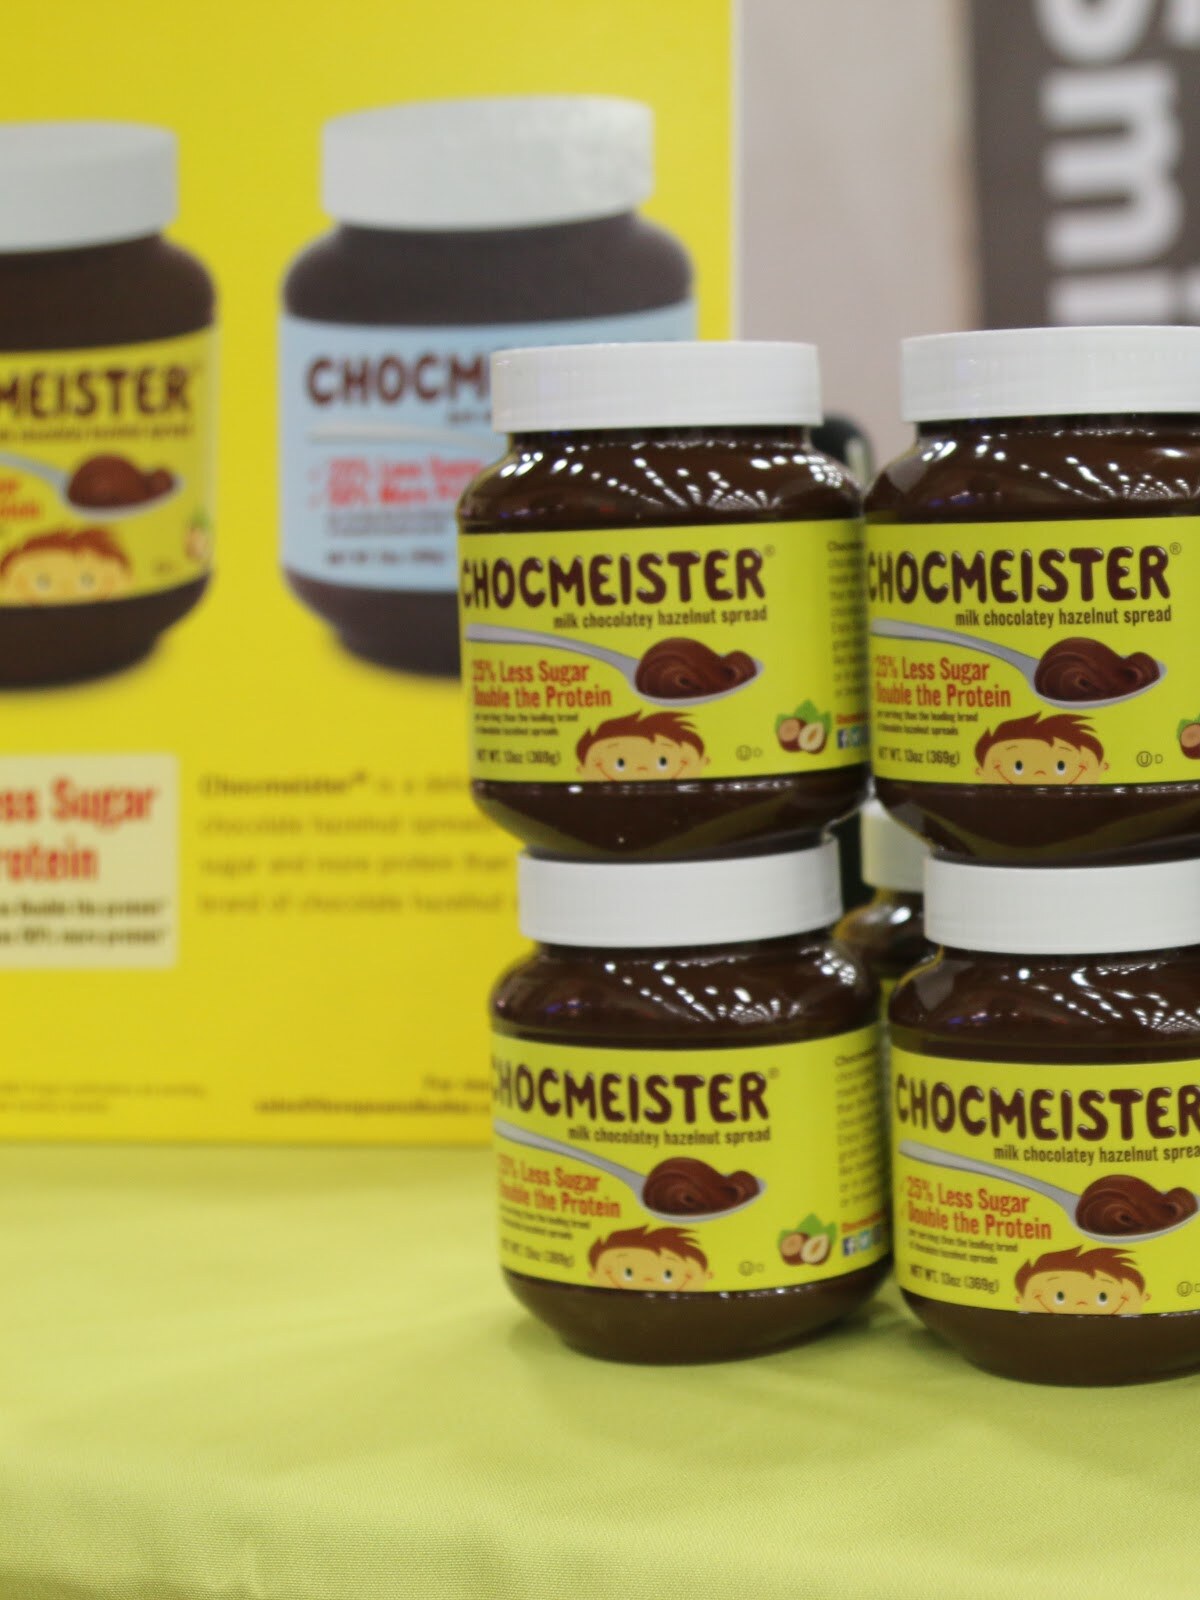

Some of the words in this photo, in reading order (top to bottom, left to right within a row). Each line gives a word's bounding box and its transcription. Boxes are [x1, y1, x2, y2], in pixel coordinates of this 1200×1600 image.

[553, 612, 579, 629] milk
[583, 609, 653, 629] chocolatey
[659, 607, 716, 625] hazelnut
[721, 604, 768, 625] spread
[955, 609, 980, 626] milk
[984, 607, 1054, 628] chocolatey
[1059, 606, 1119, 625] hazelnut
[1124, 605, 1172, 626] spread
[499, 660, 534, 682] Less
[538, 660, 590, 686] Sugar
[902, 656, 935, 680] Less
[940, 656, 990, 685] Sugar
[515, 687, 540, 708] the
[546, 684, 612, 708] Protein
[916, 683, 942, 706] the
[946, 684, 1012, 707] Protein
[568, 1127, 592, 1142] milk
[594, 1129, 660, 1147] chocolatey
[664, 1128, 720, 1145] hazelnut
[725, 1126, 771, 1145] spread
[994, 1144, 1019, 1162] milk
[1024, 1145, 1095, 1166] chocolatey
[1100, 1145, 1159, 1163] hazelnut
[938, 1182, 973, 1209] Less
[978, 1188, 1030, 1217] Sugar
[953, 1211, 979, 1234] the
[985, 1214, 1052, 1240] Protein
